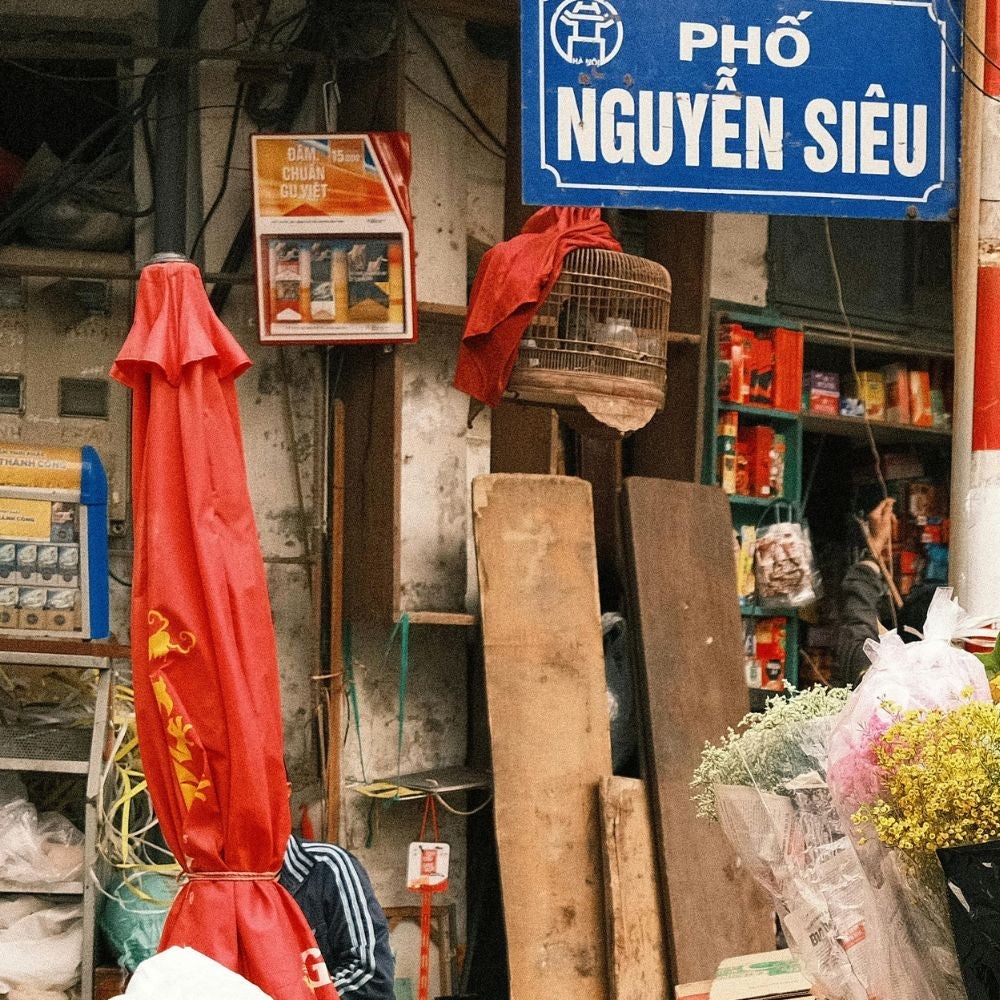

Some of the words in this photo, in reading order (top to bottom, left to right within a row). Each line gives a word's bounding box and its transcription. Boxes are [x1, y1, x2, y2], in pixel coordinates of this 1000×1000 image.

[678, 11, 811, 68] PHỐ
[556, 67, 784, 170] NGUYỄN
[803, 84, 928, 178] SIÊU
